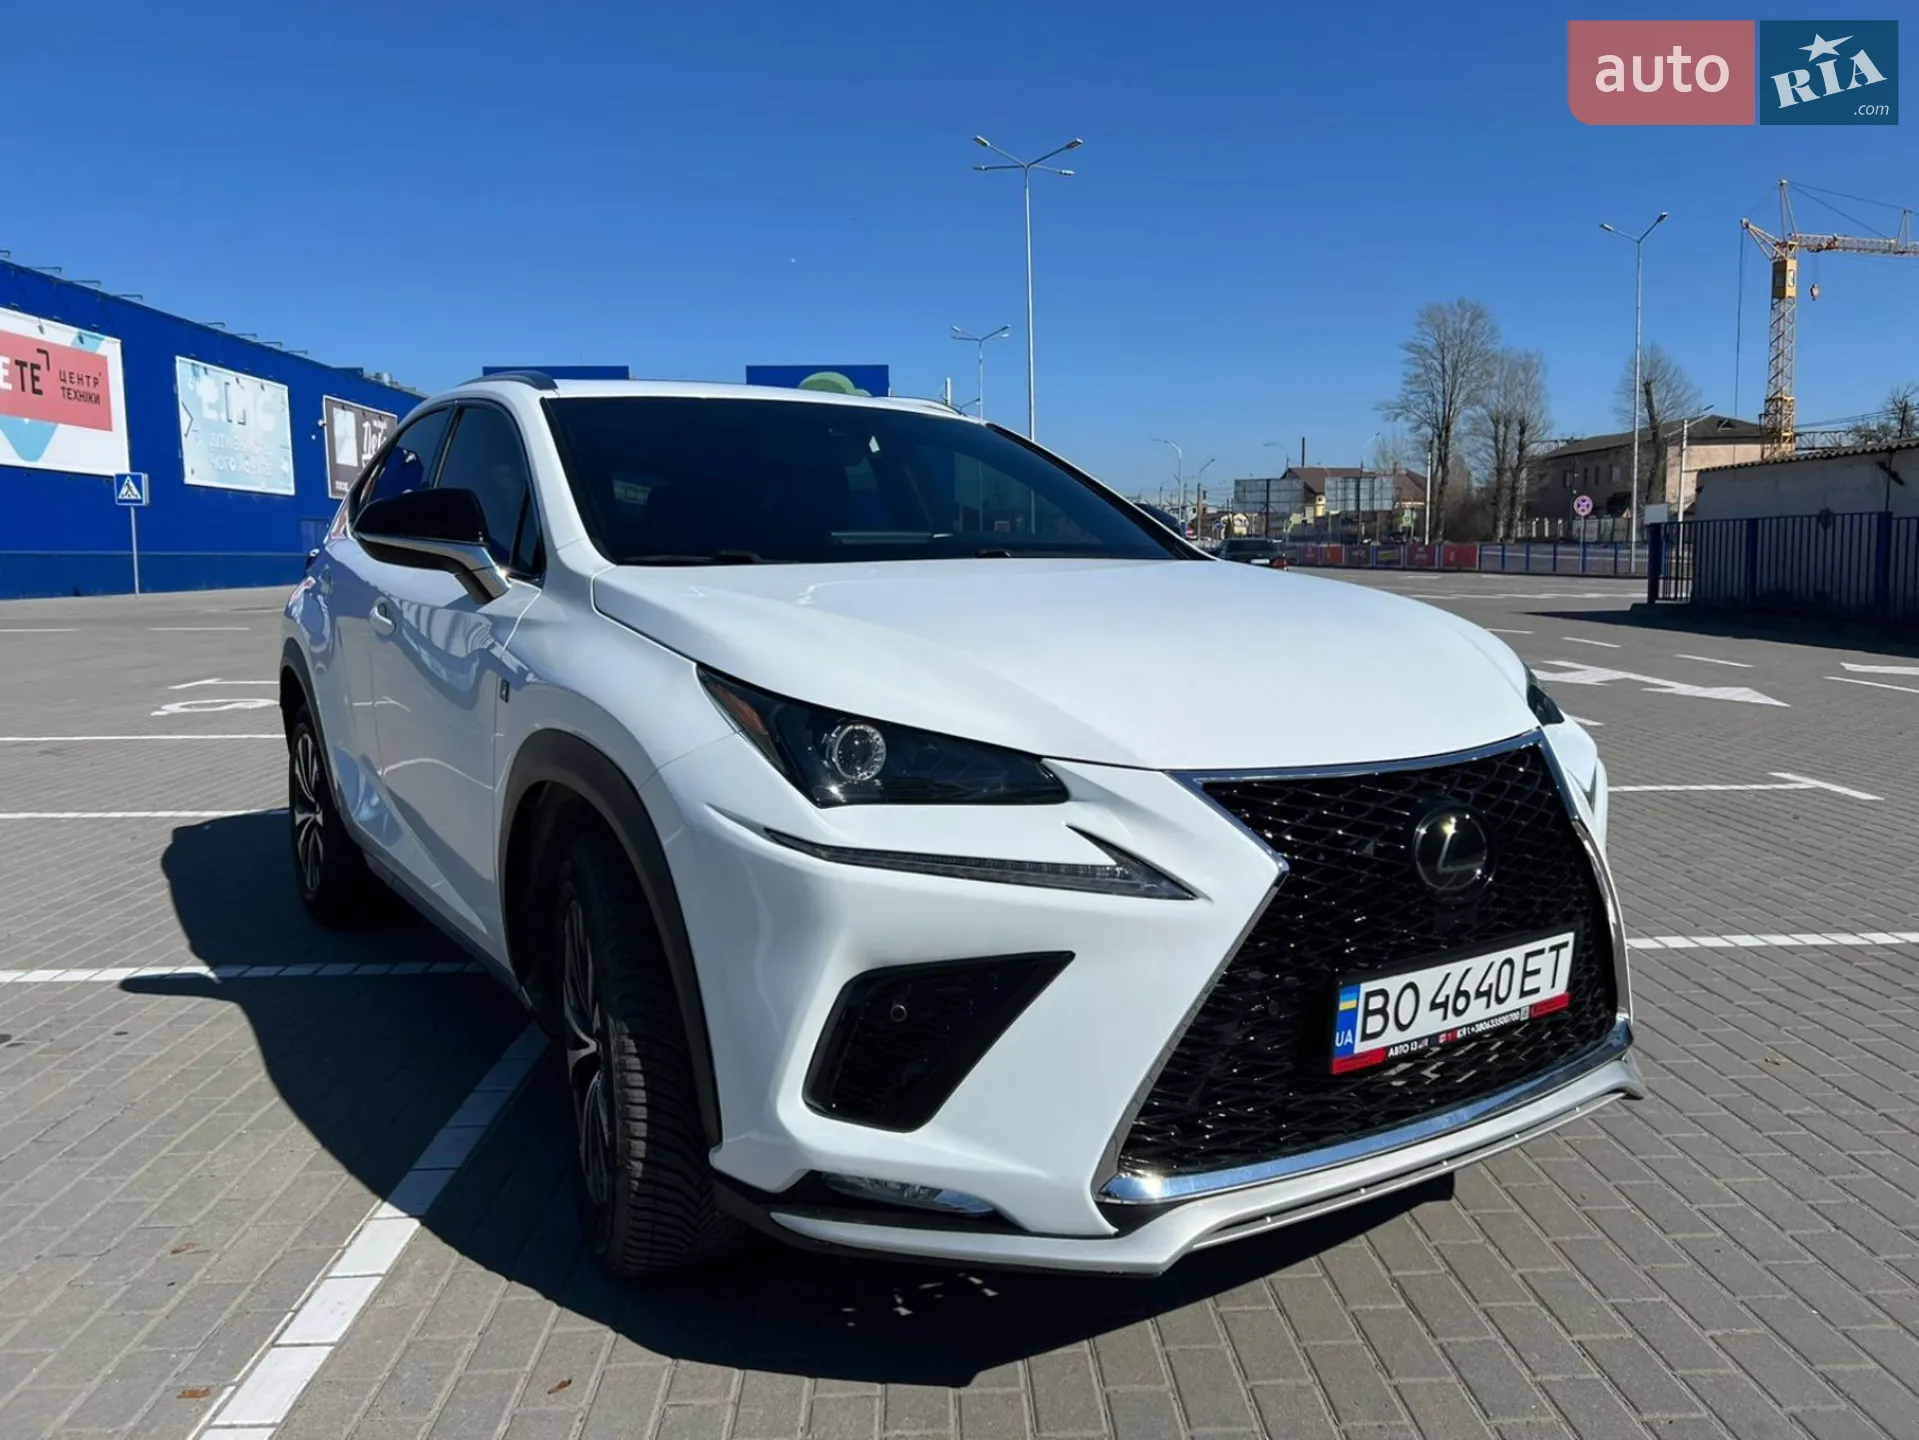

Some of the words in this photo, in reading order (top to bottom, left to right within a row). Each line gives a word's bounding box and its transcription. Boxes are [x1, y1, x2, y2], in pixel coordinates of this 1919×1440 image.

[59, 369, 100, 388] ЦЕНТР
[60, 387, 101, 405] ТЕХНІКИ
[1360, 981, 1420, 1043] BO
[1429, 957, 1516, 1021] 4640
[1519, 941, 1570, 999] ET
[1335, 1031, 1354, 1047] UA
